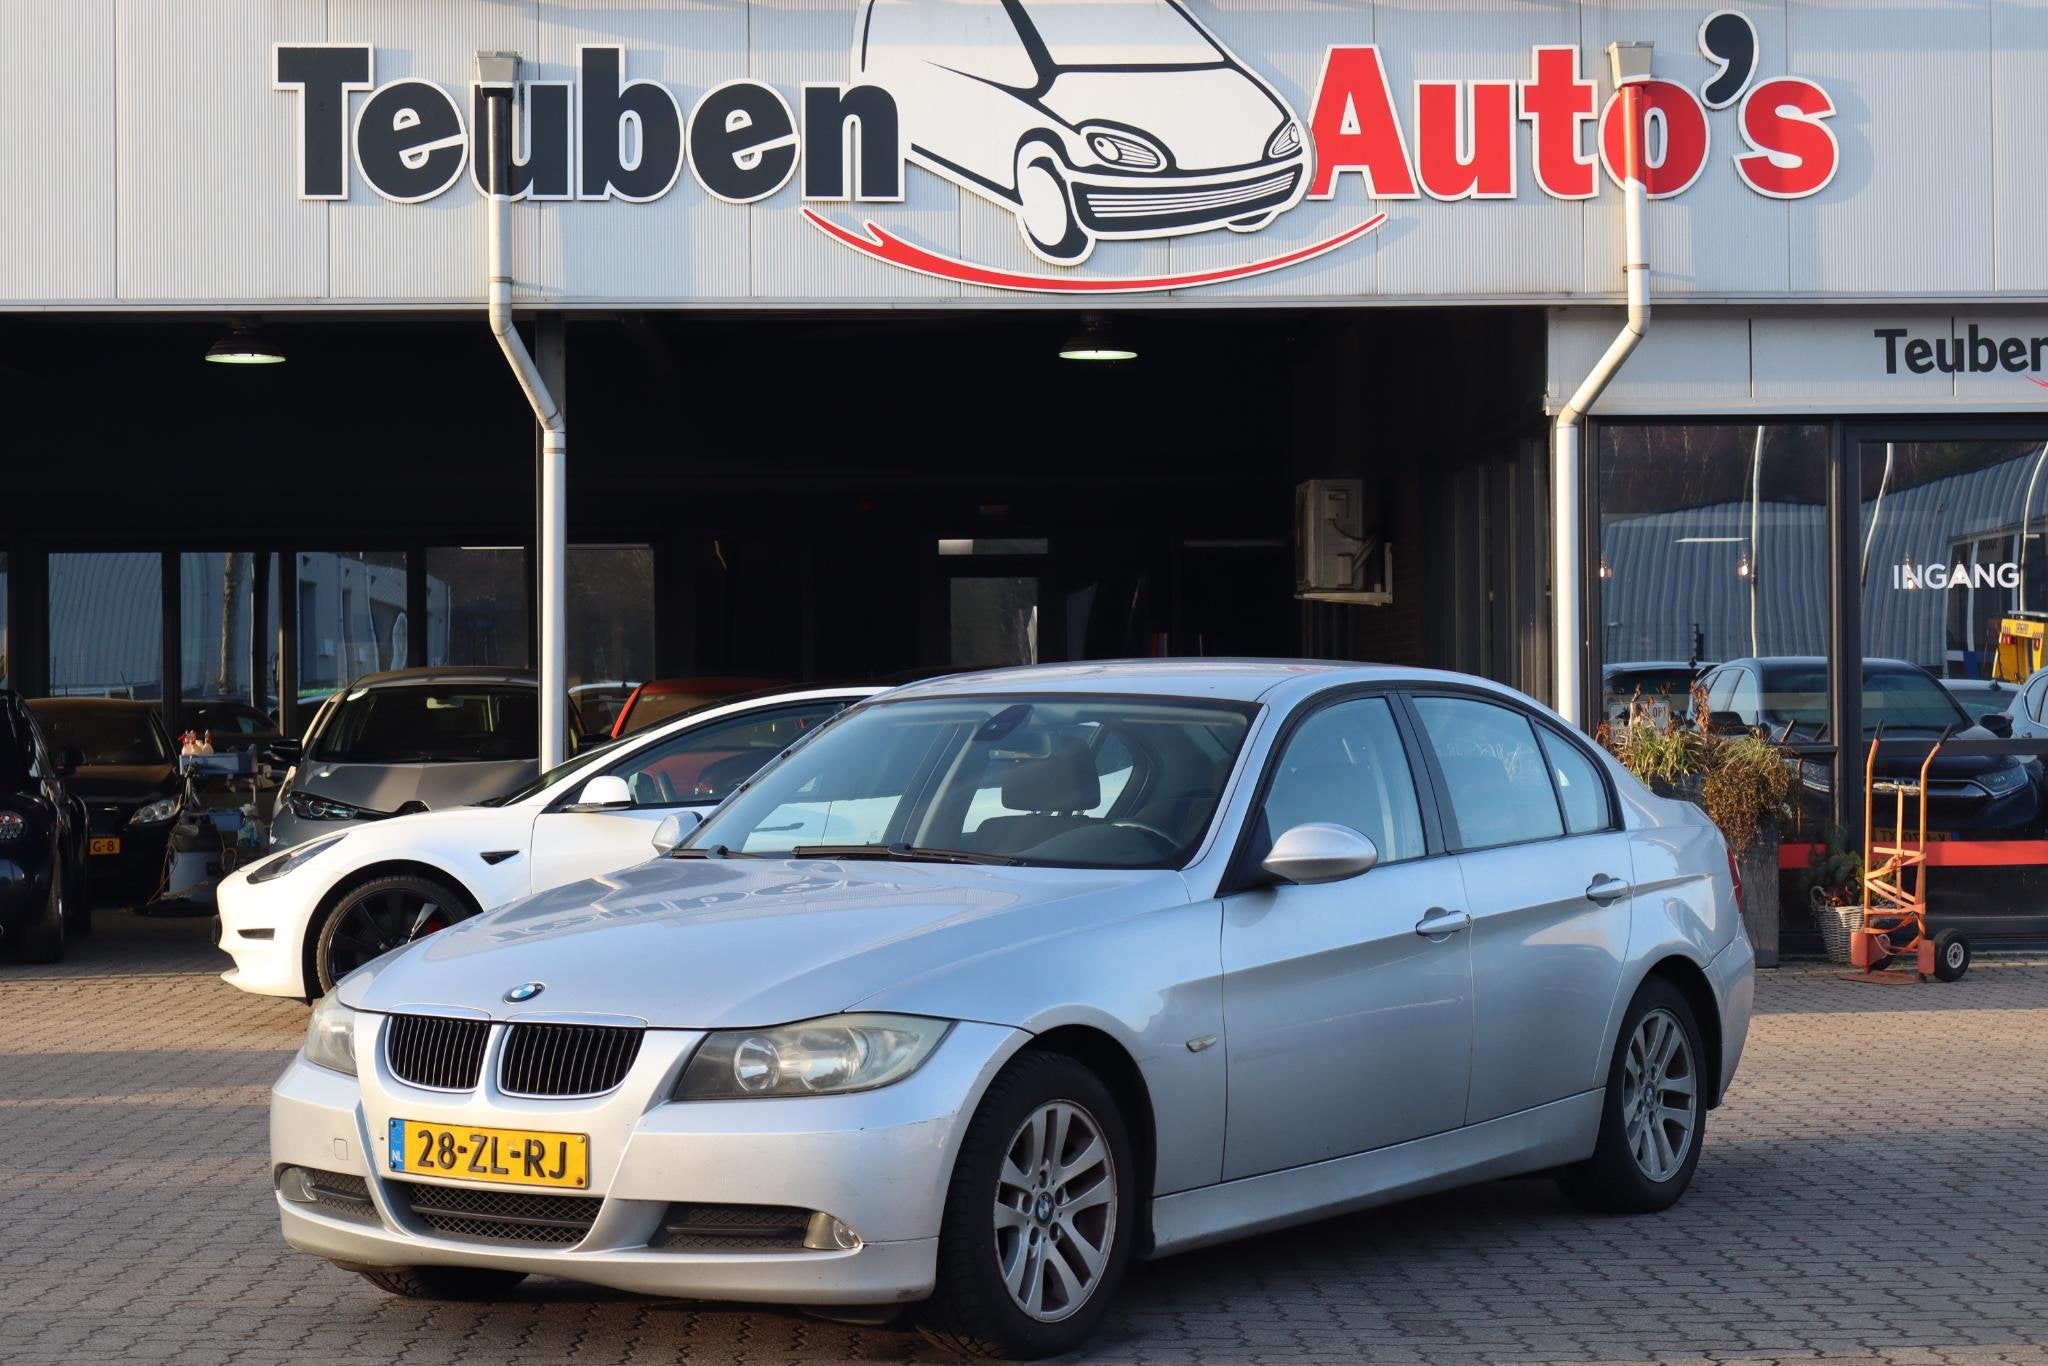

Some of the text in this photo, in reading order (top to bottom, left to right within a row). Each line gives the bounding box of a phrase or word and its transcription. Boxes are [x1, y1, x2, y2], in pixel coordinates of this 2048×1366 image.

[274, 9, 1839, 202] Teuben Auto's
[1893, 563, 2020, 589] INGANG
[417, 1129, 567, 1179] 28-ZL-RJ
